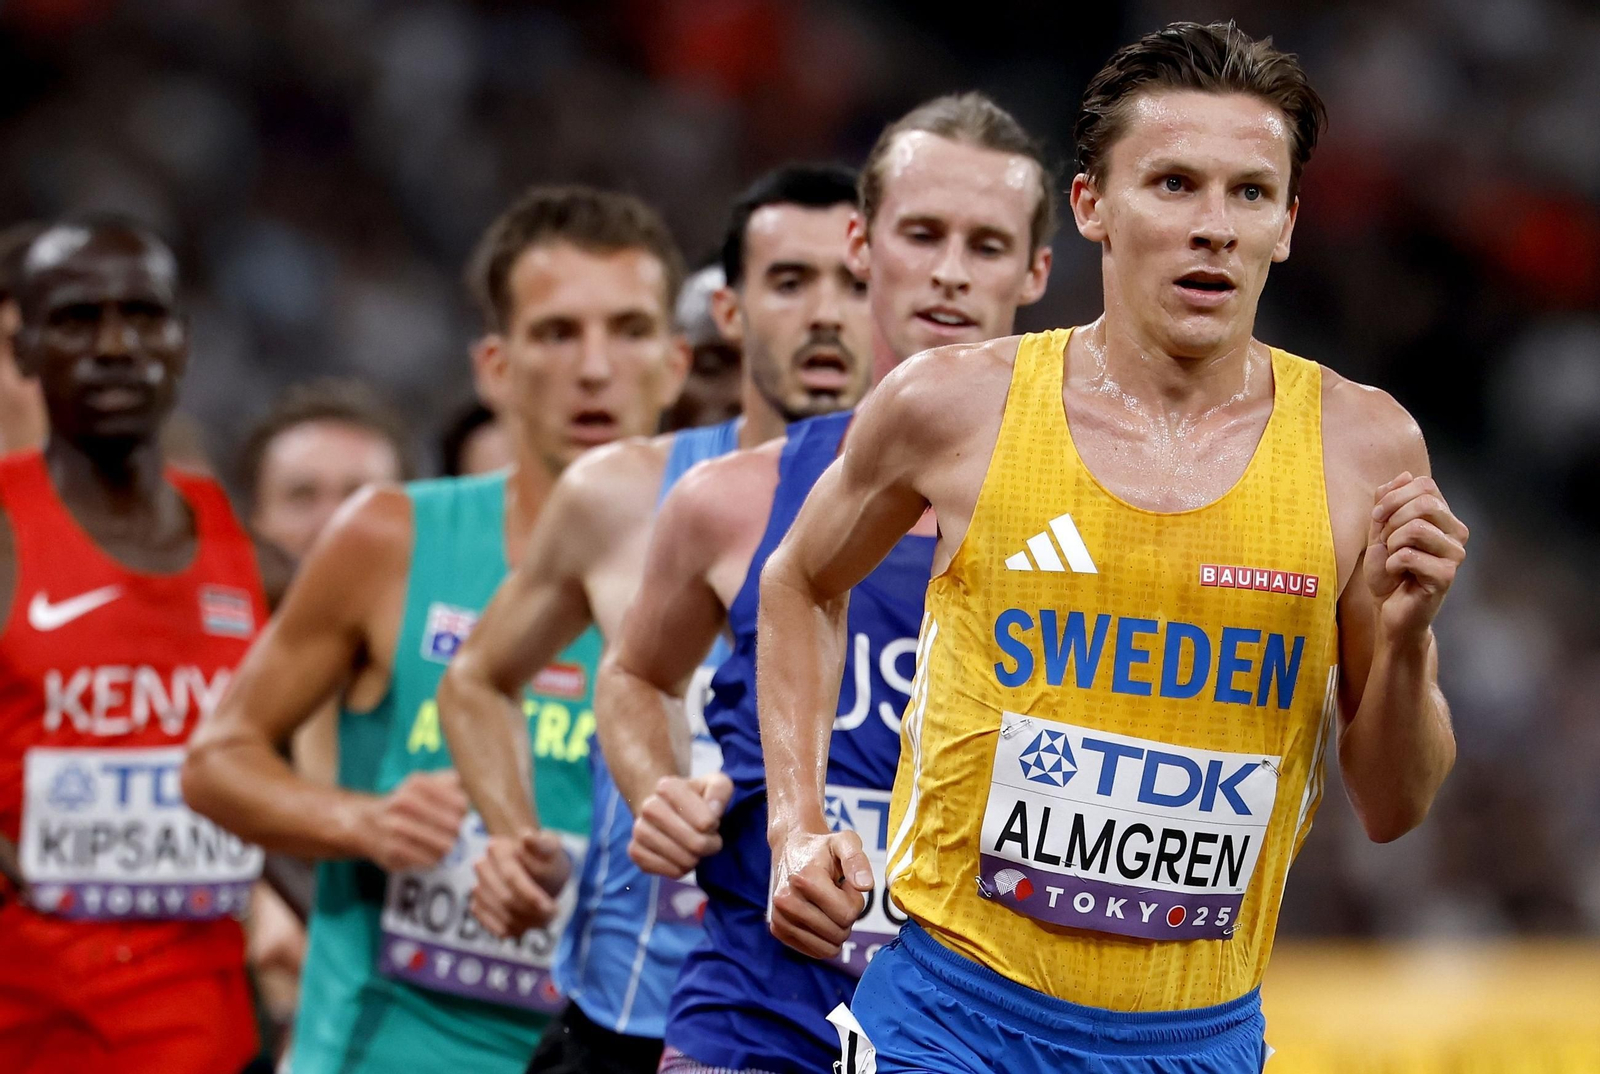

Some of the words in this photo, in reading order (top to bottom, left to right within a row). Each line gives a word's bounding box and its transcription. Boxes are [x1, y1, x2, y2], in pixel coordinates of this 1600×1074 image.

[1202, 567, 1317, 595] BAUHAUS
[994, 608, 1306, 709] SWEDEN
[43, 664, 234, 737] KENY
[1081, 737, 1262, 816] TDK
[993, 800, 1251, 887] ALMGREN
[1045, 885, 1187, 928] TOKYO
